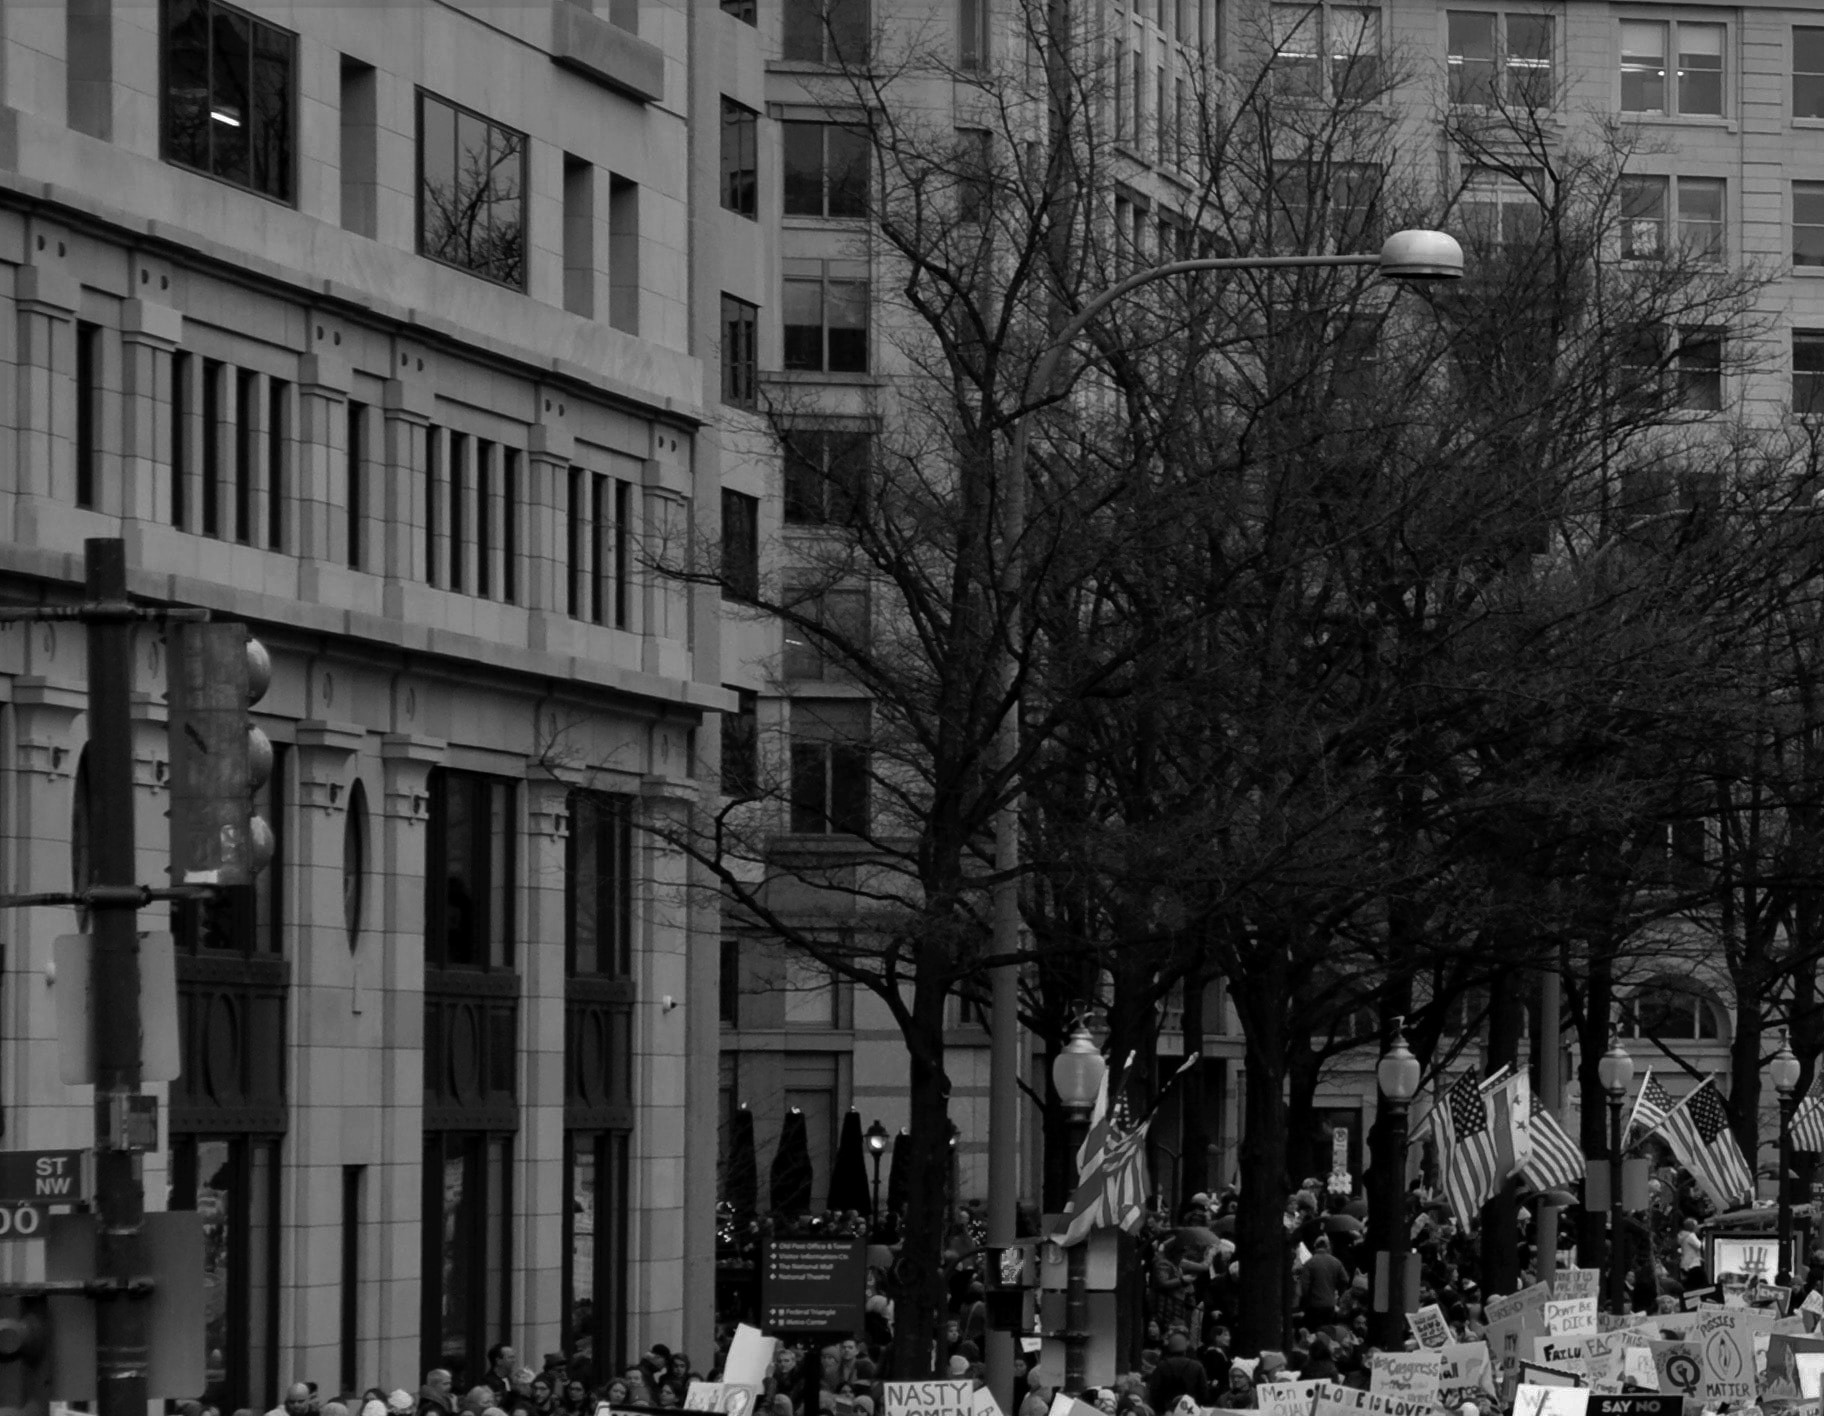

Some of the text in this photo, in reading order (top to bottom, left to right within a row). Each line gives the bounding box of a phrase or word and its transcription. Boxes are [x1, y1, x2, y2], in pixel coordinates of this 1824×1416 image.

[35, 1158, 66, 1176] ST
[35, 1177, 71, 1195] NW
[887, 1383, 969, 1406] NASTY
